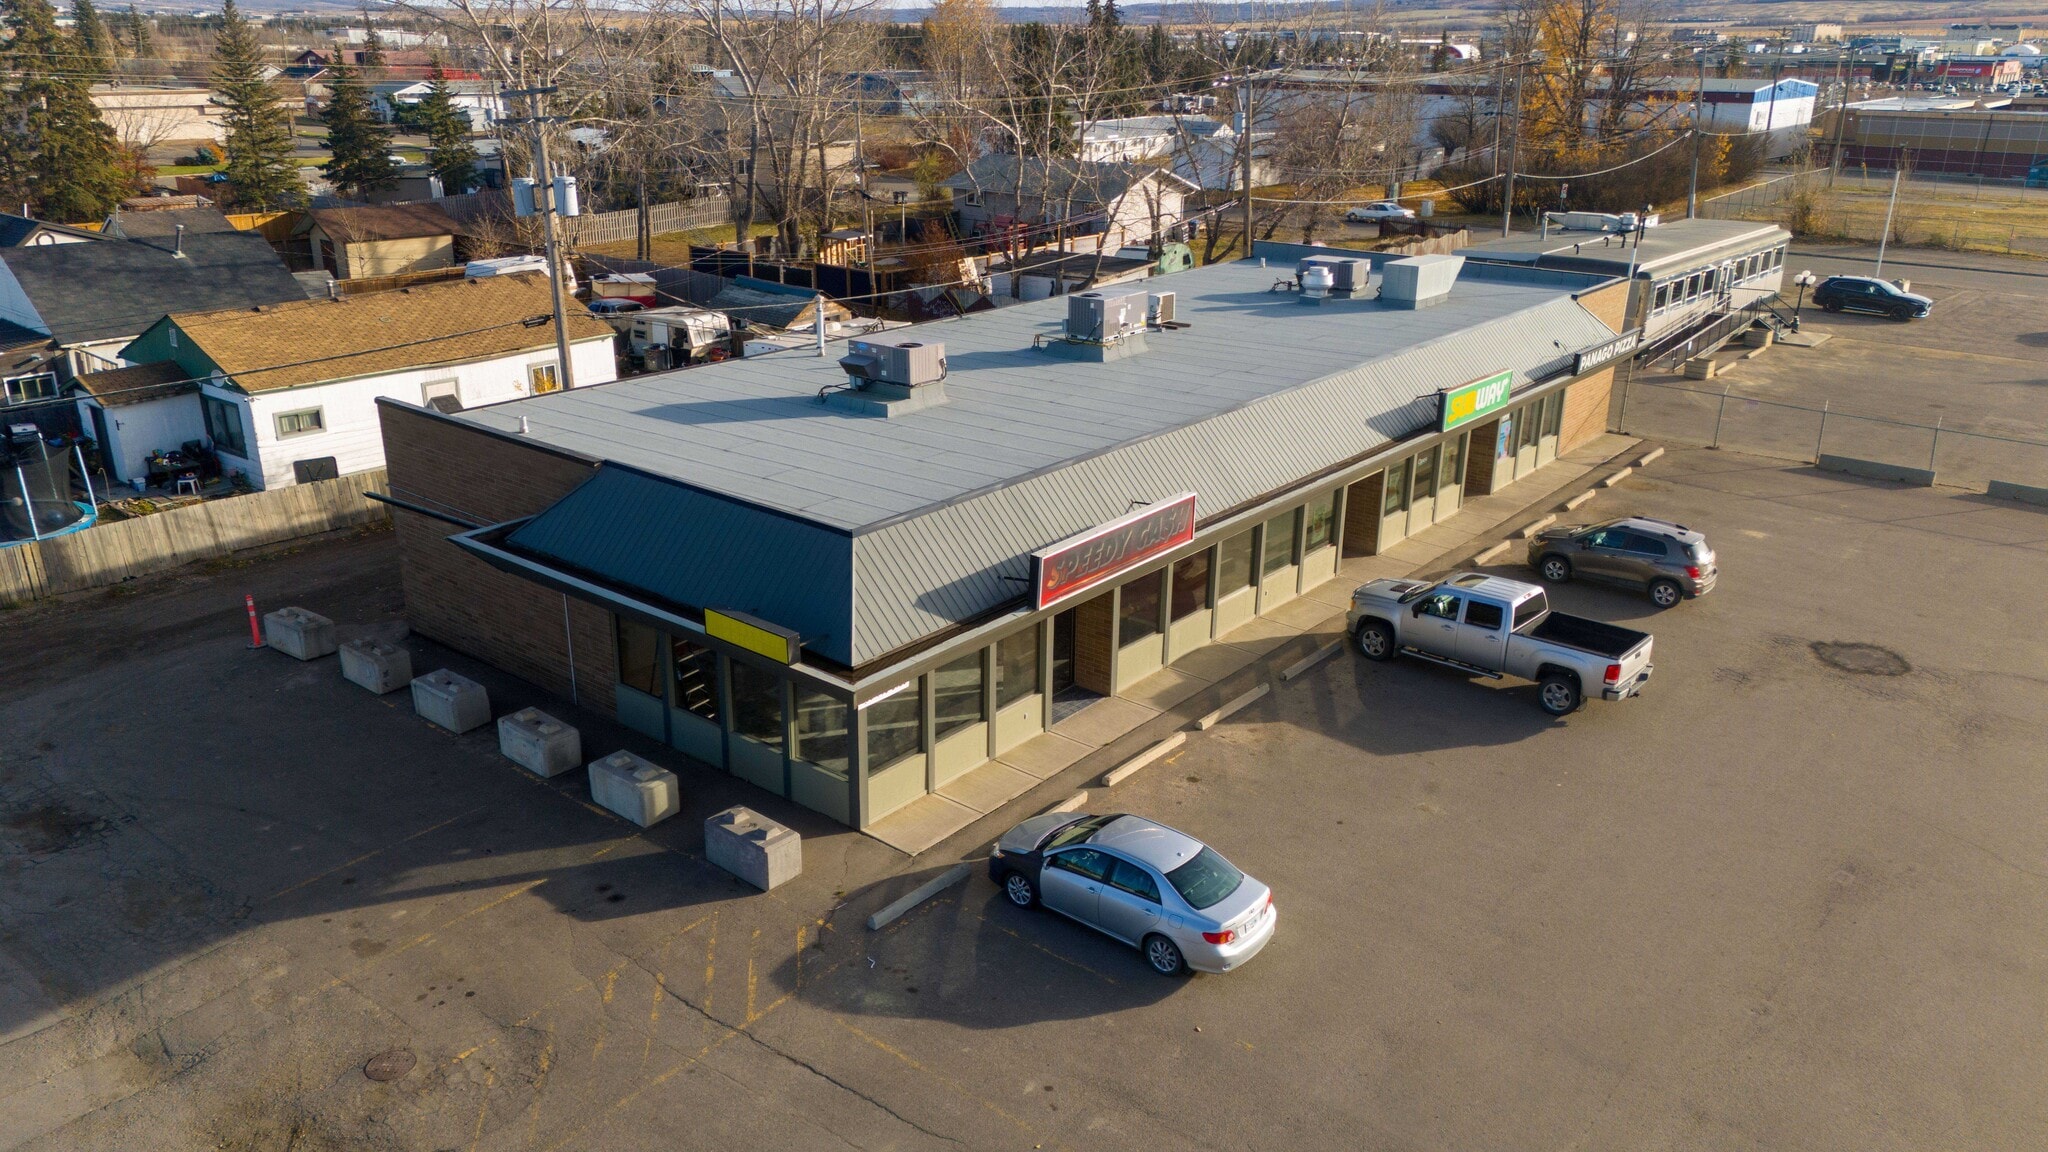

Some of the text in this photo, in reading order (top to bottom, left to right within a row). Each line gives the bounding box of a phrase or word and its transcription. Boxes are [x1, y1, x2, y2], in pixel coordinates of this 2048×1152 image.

[1580, 334, 1637, 371] PANAGO PIZZA
[1047, 528, 1134, 590] SPEEDY
